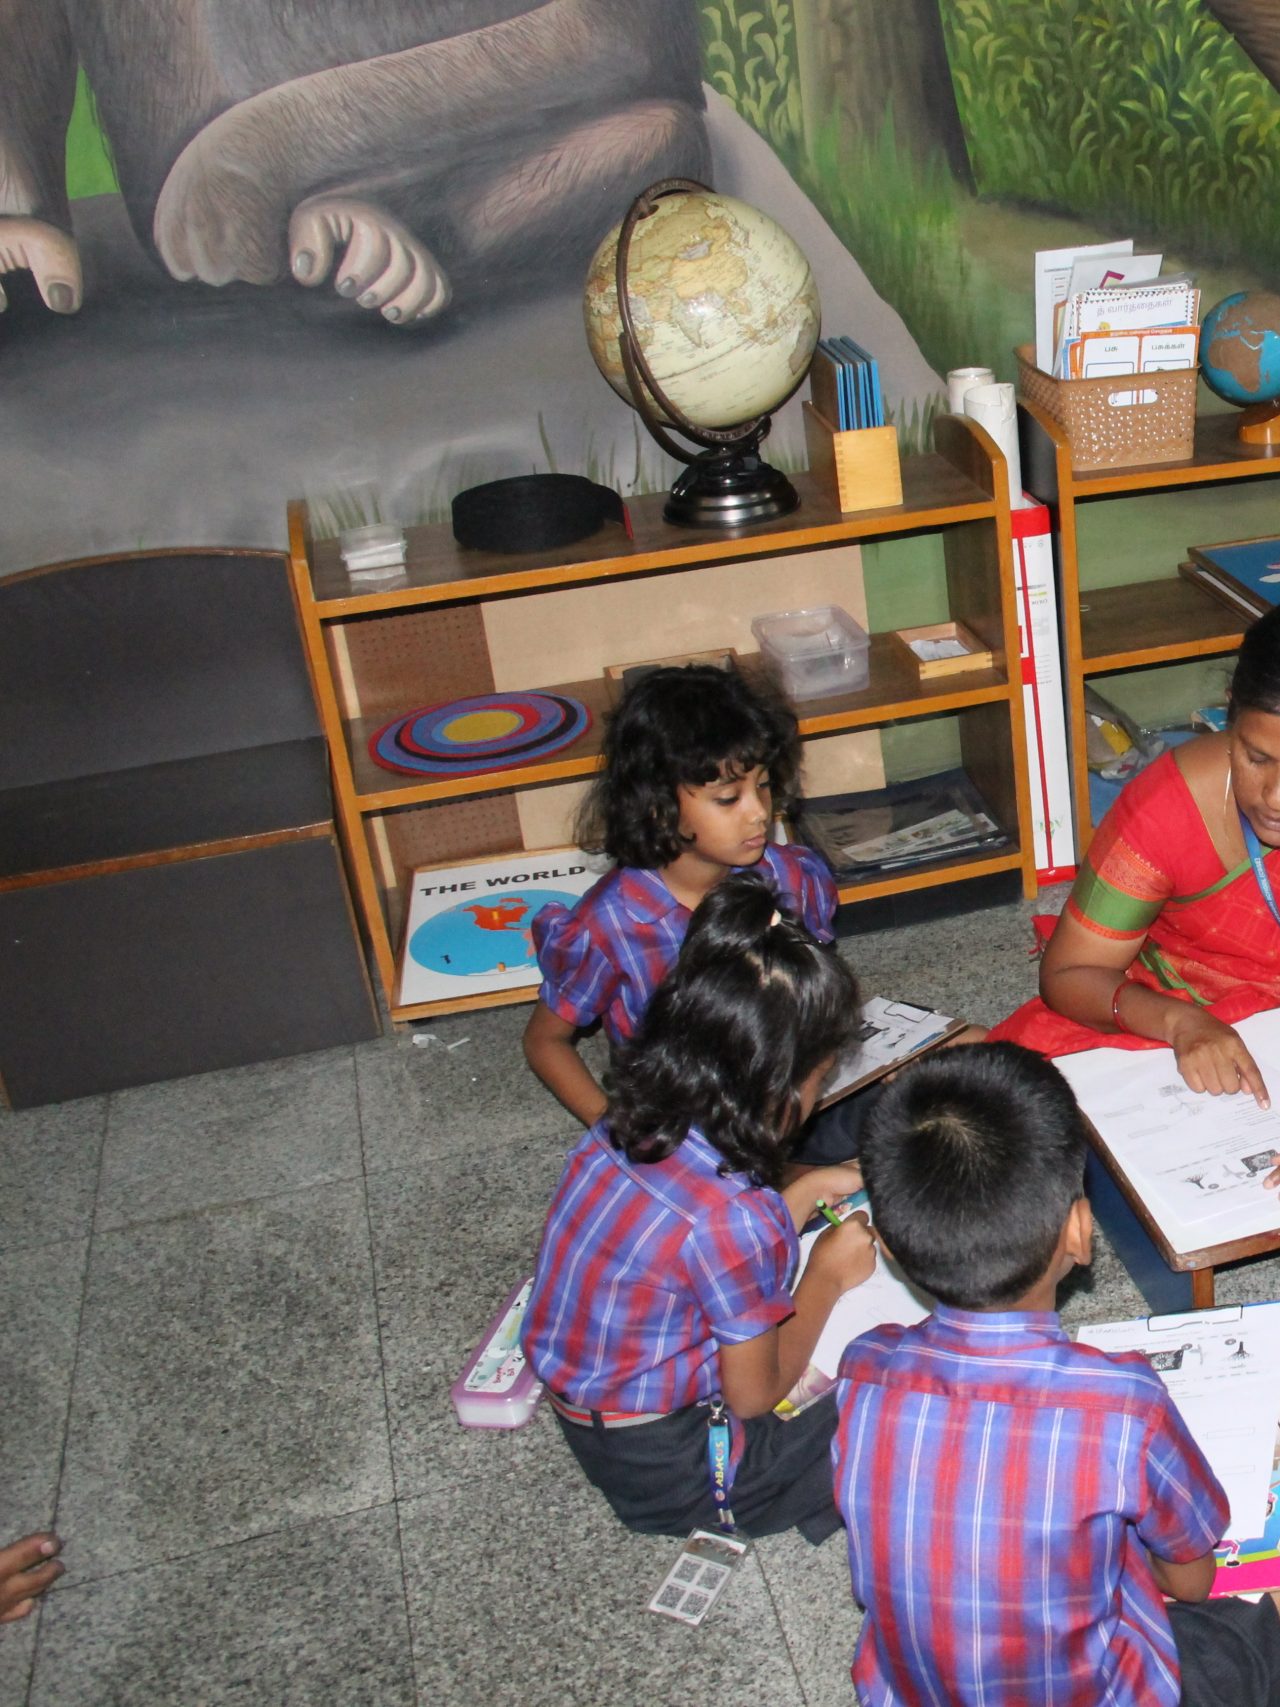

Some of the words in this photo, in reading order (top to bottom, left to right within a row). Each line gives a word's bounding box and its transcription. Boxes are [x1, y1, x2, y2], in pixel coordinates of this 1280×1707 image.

[420, 881, 477, 897] THE
[486, 866, 587, 888] WORLD
[715, 1441, 725, 1488] ABACUS
